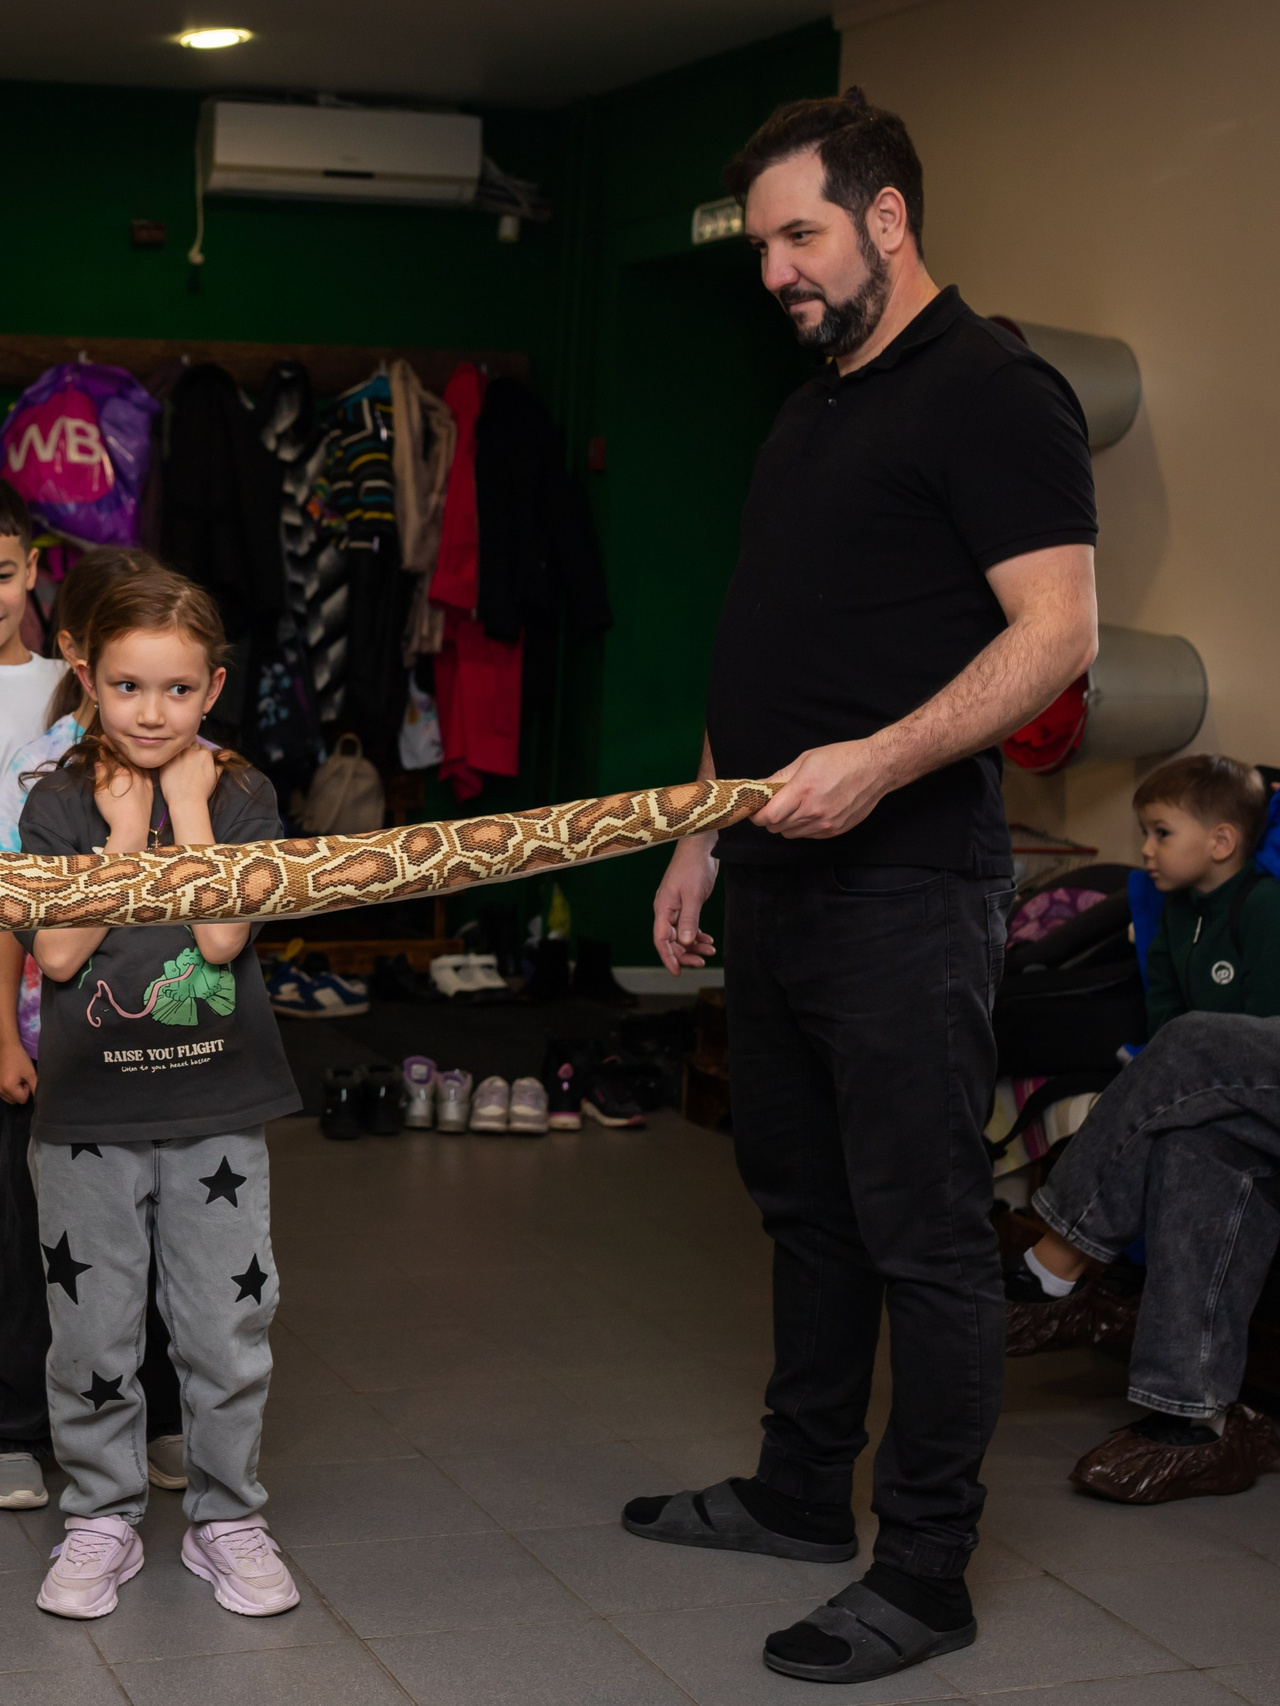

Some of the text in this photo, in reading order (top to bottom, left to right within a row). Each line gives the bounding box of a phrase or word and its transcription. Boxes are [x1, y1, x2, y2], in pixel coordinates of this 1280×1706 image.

[8, 415, 102, 473] WB
[103, 1039, 224, 1062] RAISE YOU FLIGHT
